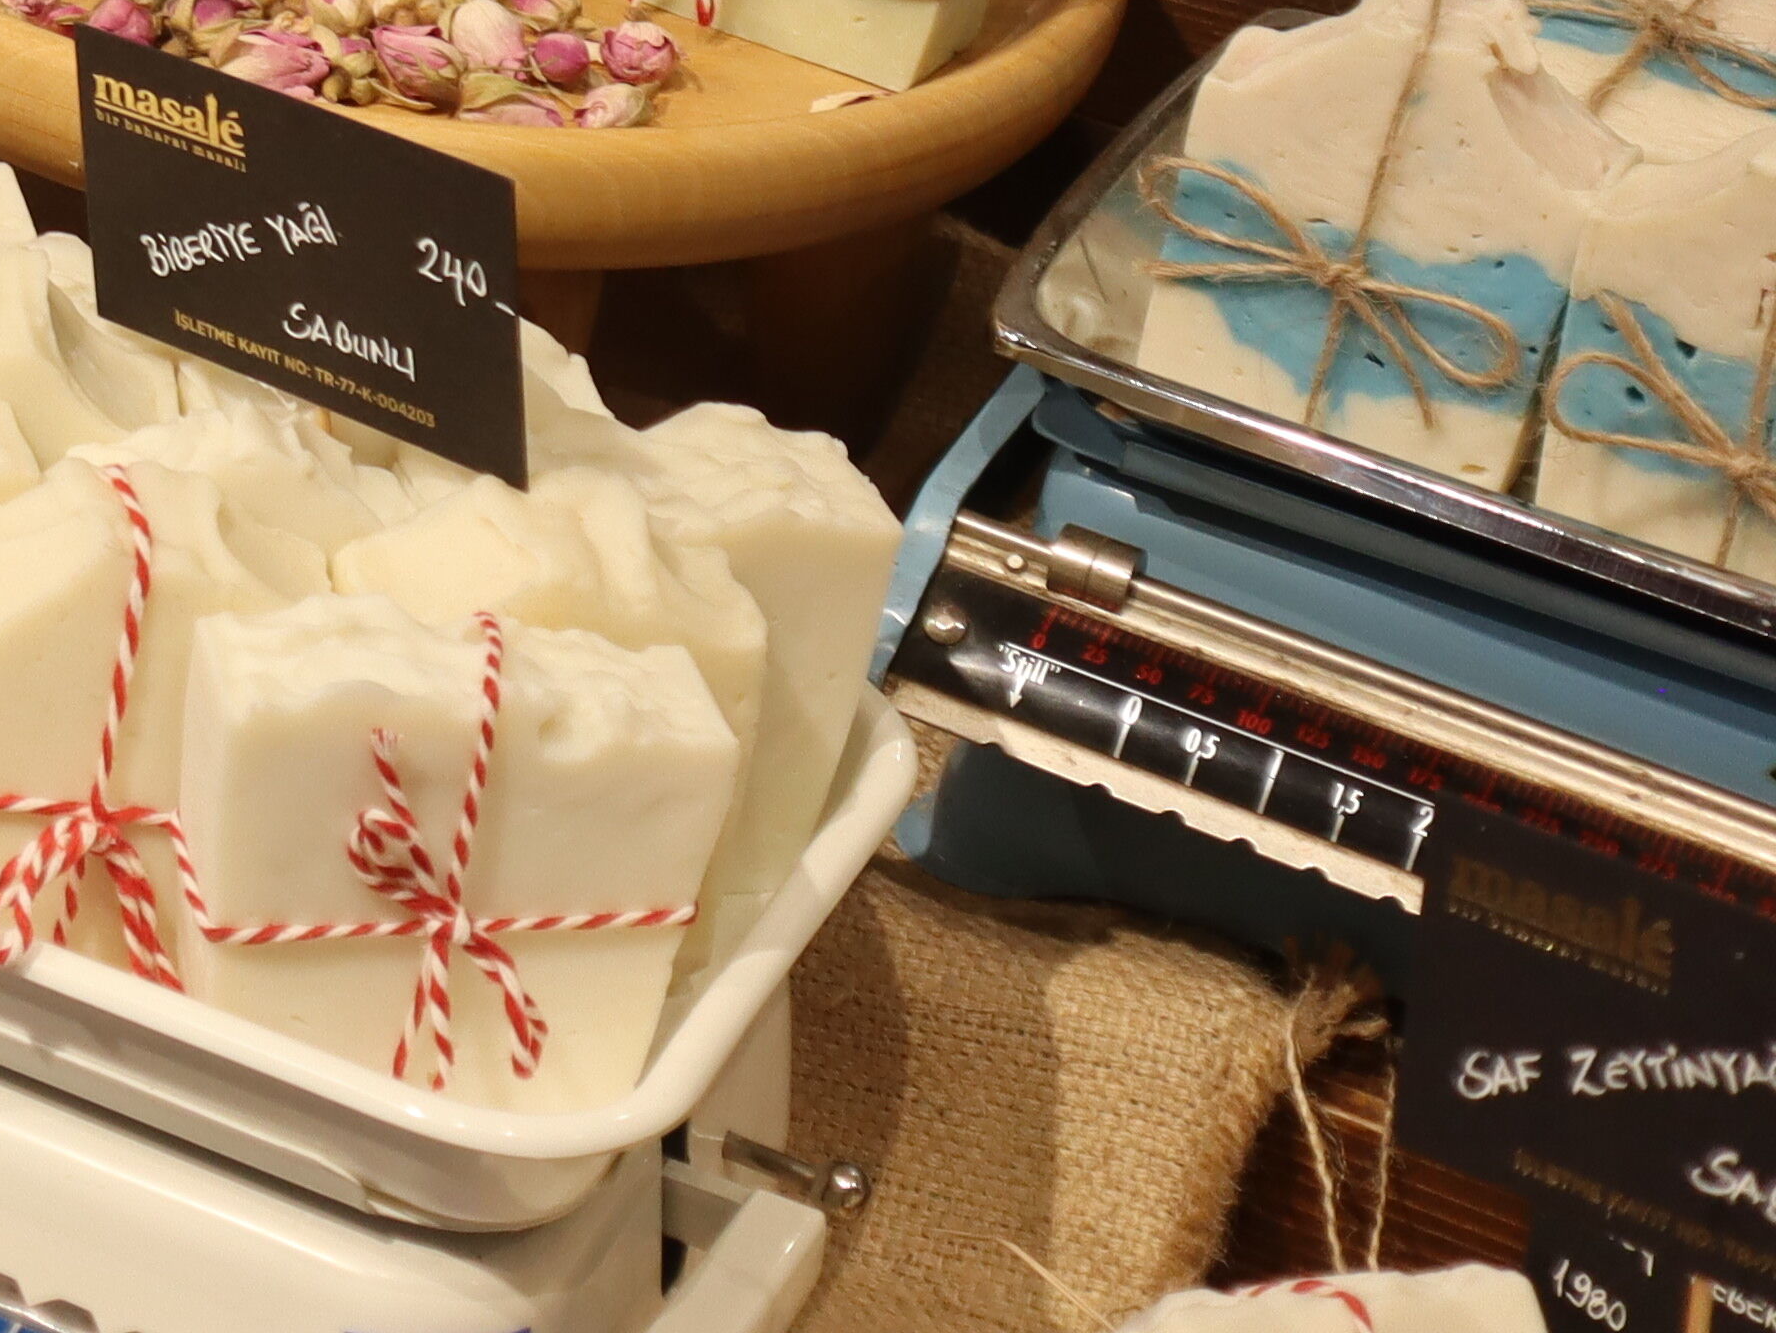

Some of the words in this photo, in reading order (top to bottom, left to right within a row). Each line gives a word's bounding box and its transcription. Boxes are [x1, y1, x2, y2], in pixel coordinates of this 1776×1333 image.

[92, 74, 246, 151] masalé
[96, 107, 119, 125] bir
[139, 221, 262, 278] BİBERİYE
[264, 201, 341, 255] YAĞI
[174, 308, 236, 350] İŞLETME
[236, 335, 282, 367] KAYIT
[284, 353, 313, 379] NO:
[281, 301, 417, 383] SABUNU
[1236, 709, 1274, 735] 100
[1120, 695, 1144, 726] 0
[1411, 805, 1436, 838] 2
[1457, 1050, 1542, 1100] SAF
